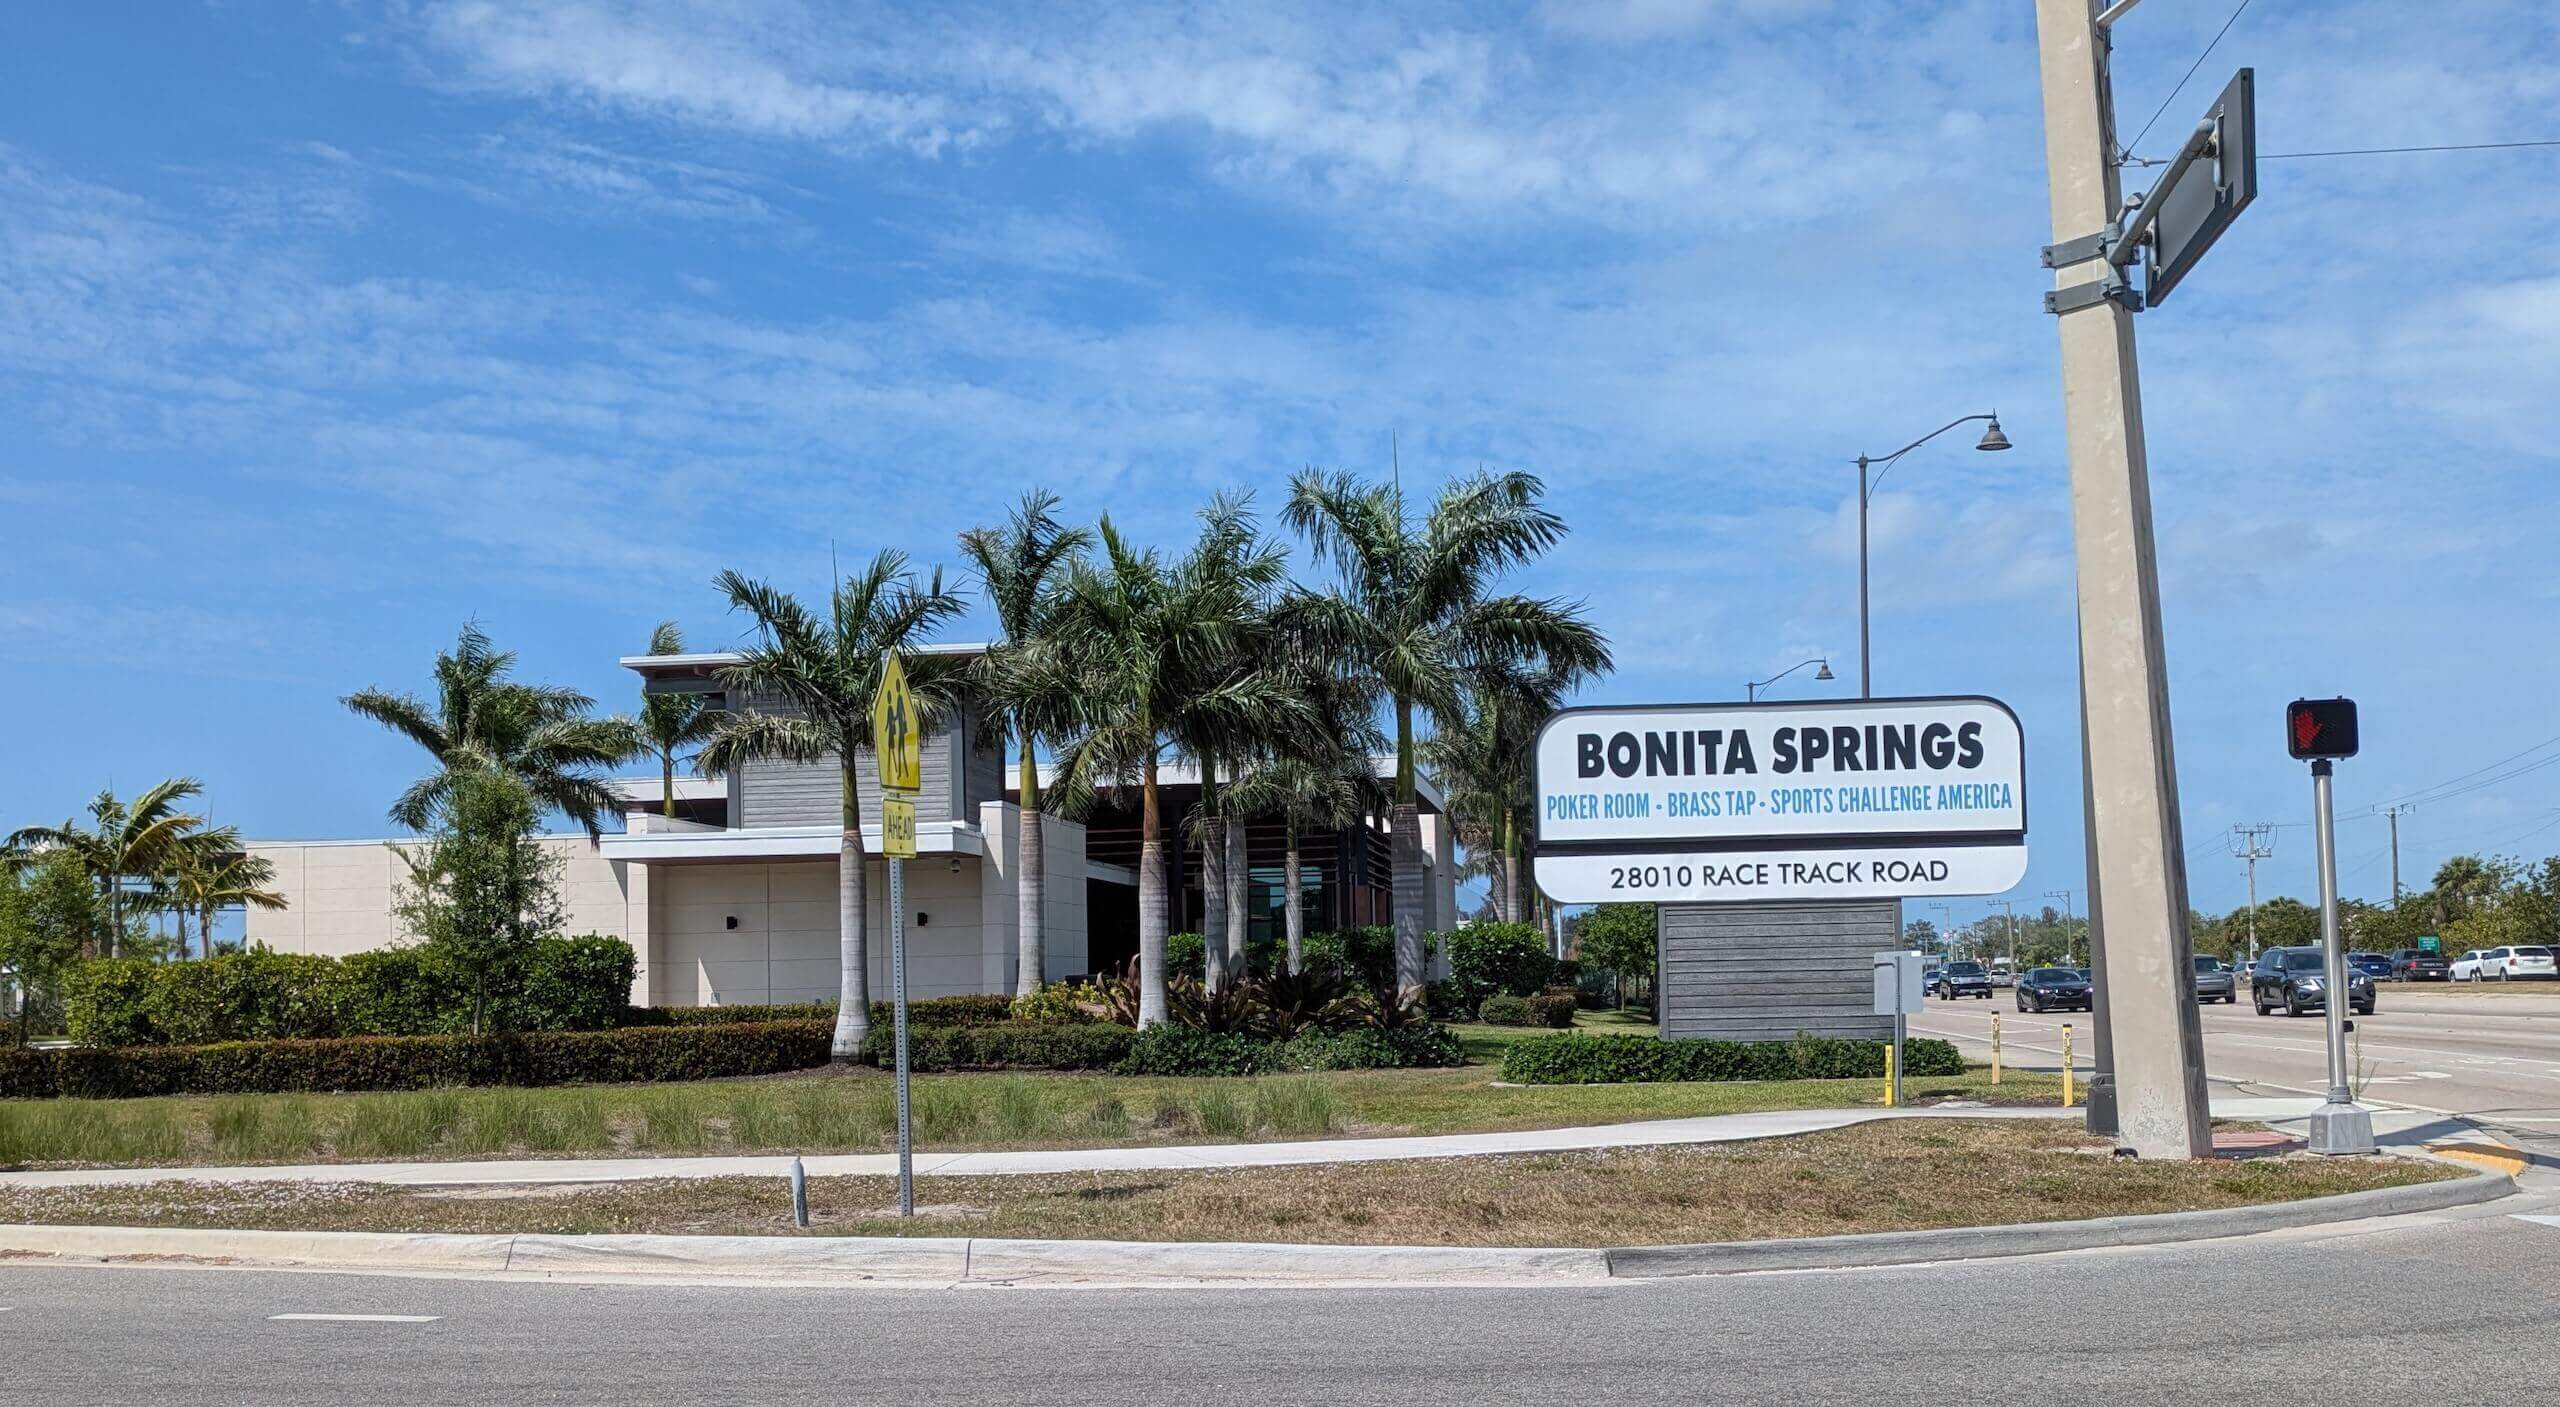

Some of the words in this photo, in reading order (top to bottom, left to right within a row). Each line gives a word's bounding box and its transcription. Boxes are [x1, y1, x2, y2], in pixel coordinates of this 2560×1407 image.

[1576, 729, 1758, 779] BONITA
[1772, 721, 1984, 775] SPRINGS
[1547, 793, 1599, 821] POKER
[1603, 792, 1650, 819] ROOM
[1667, 791, 1721, 818] BRASS
[1724, 789, 1756, 817] TAP
[1770, 787, 1833, 815] SPORTS
[1837, 785, 1932, 814] CHALLENGE
[1936, 782, 2013, 811] AMERICA
[887, 813, 913, 841] AHEAD
[1610, 865, 1693, 889] 28010
[1702, 863, 1769, 887] RACE
[1777, 861, 1863, 885] TRACK
[1872, 860, 1949, 883] ROAD
